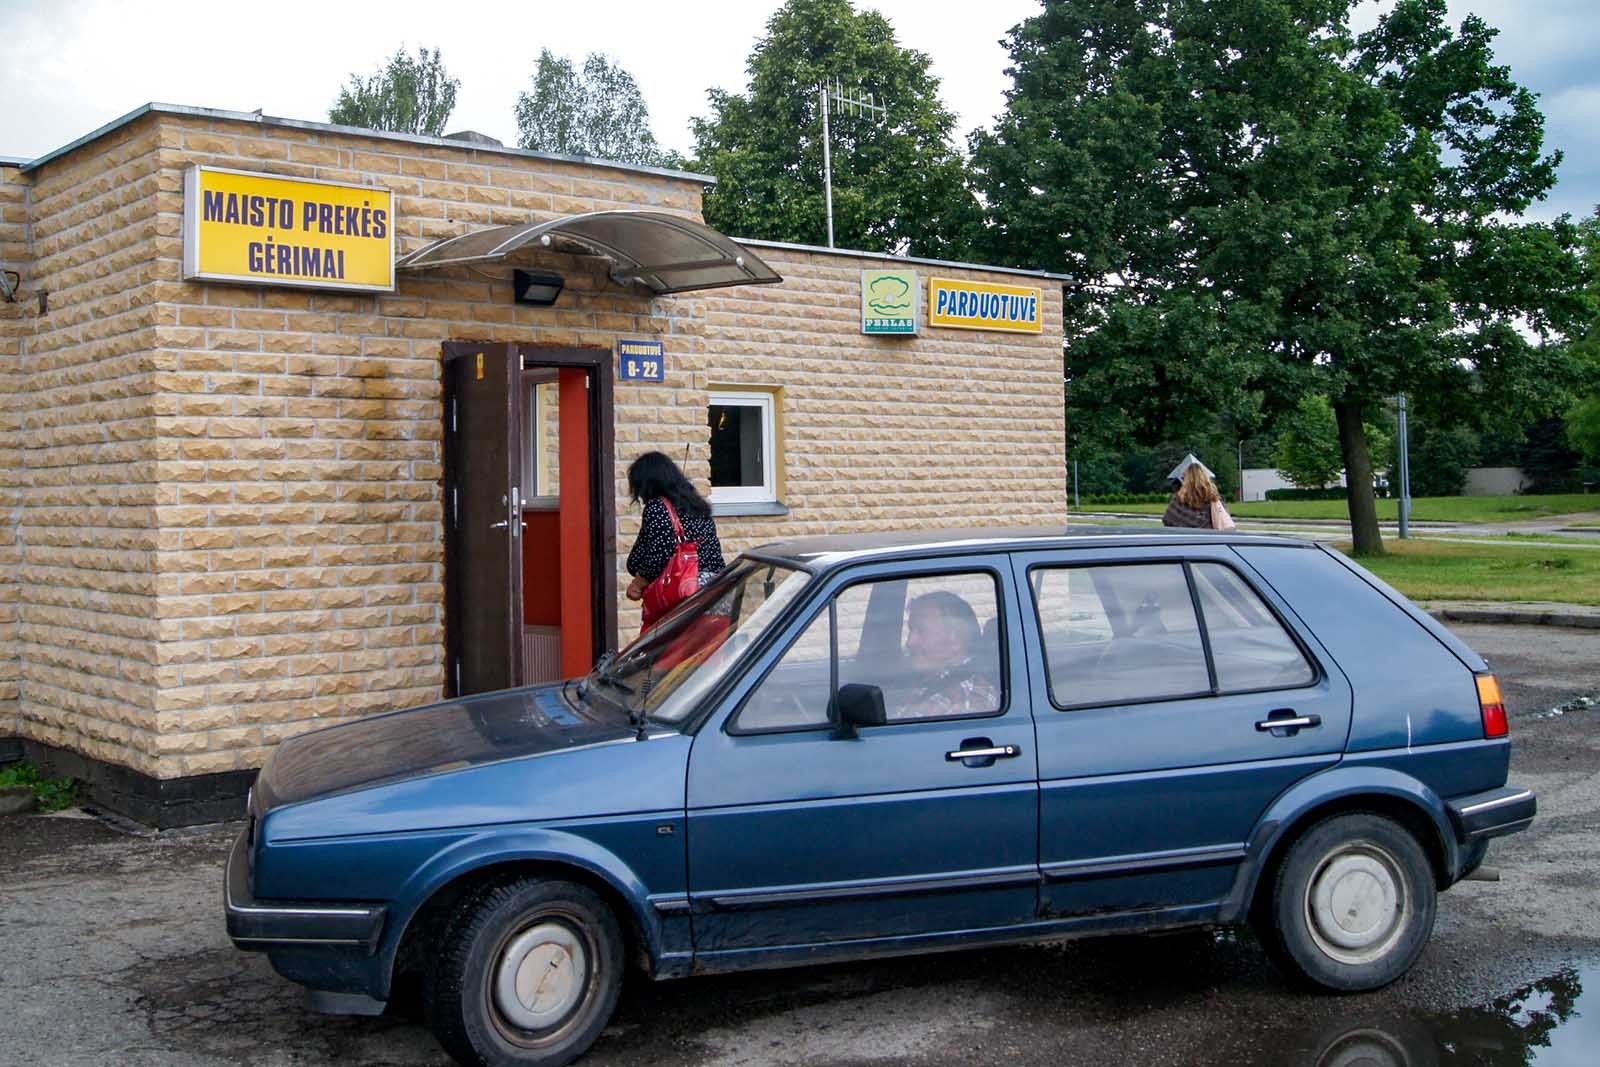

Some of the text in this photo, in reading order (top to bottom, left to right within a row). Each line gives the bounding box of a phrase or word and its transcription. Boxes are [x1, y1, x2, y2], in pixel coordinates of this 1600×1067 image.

[203, 190, 387, 239] MAISTO PREKĖS
[248, 235, 345, 280] GĖRIMAI
[865, 319, 913, 327] PERLAS
[936, 289, 1038, 322] PARDUOTUVĖ
